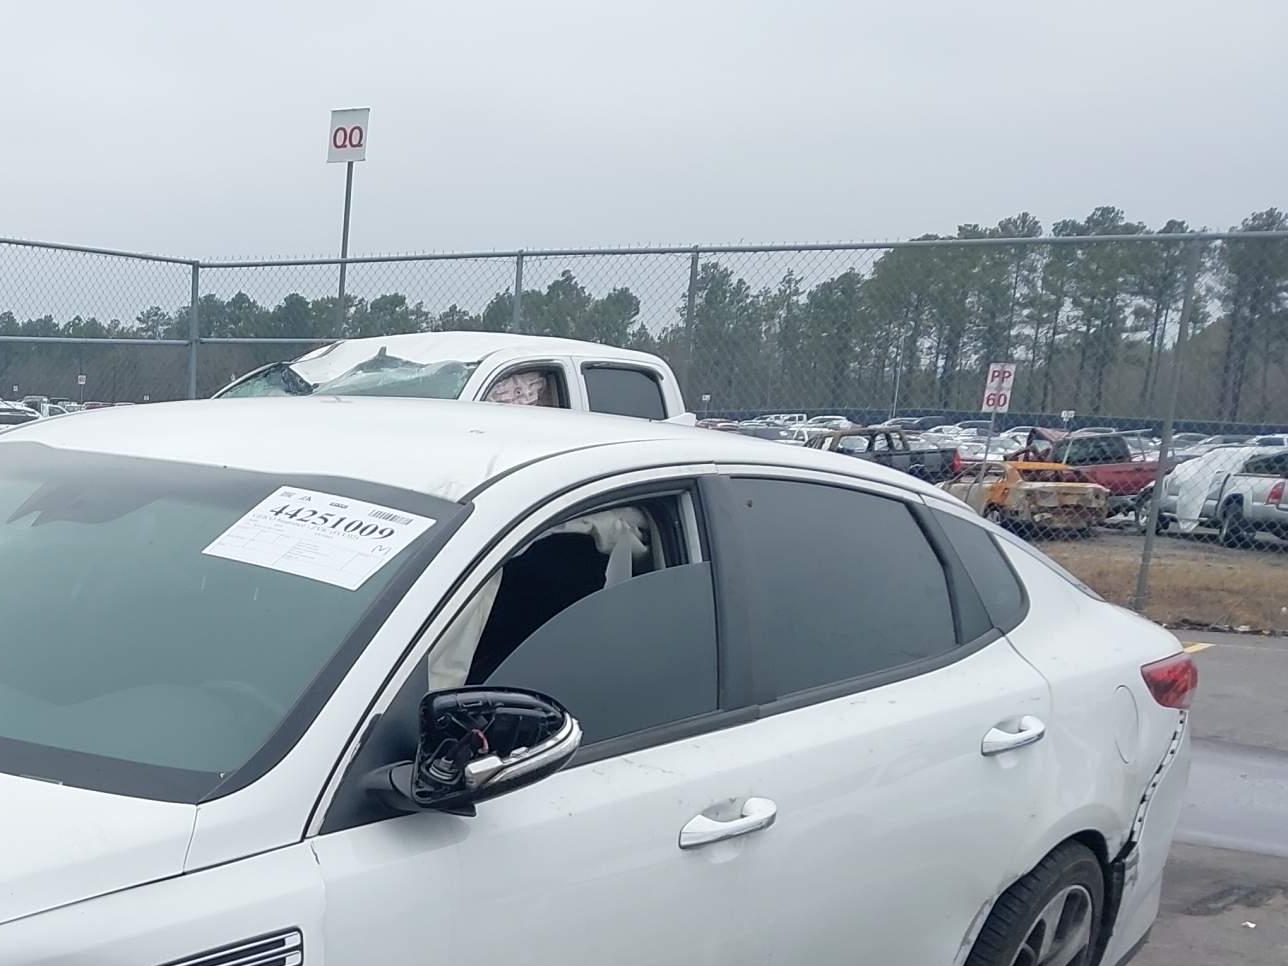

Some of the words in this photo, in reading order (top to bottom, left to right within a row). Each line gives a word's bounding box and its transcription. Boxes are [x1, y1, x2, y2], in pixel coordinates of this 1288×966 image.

[333, 126, 363, 148] QQ
[991, 370, 1011, 384] PP
[986, 393, 1007, 407] 60
[270, 504, 395, 539] 44251009
